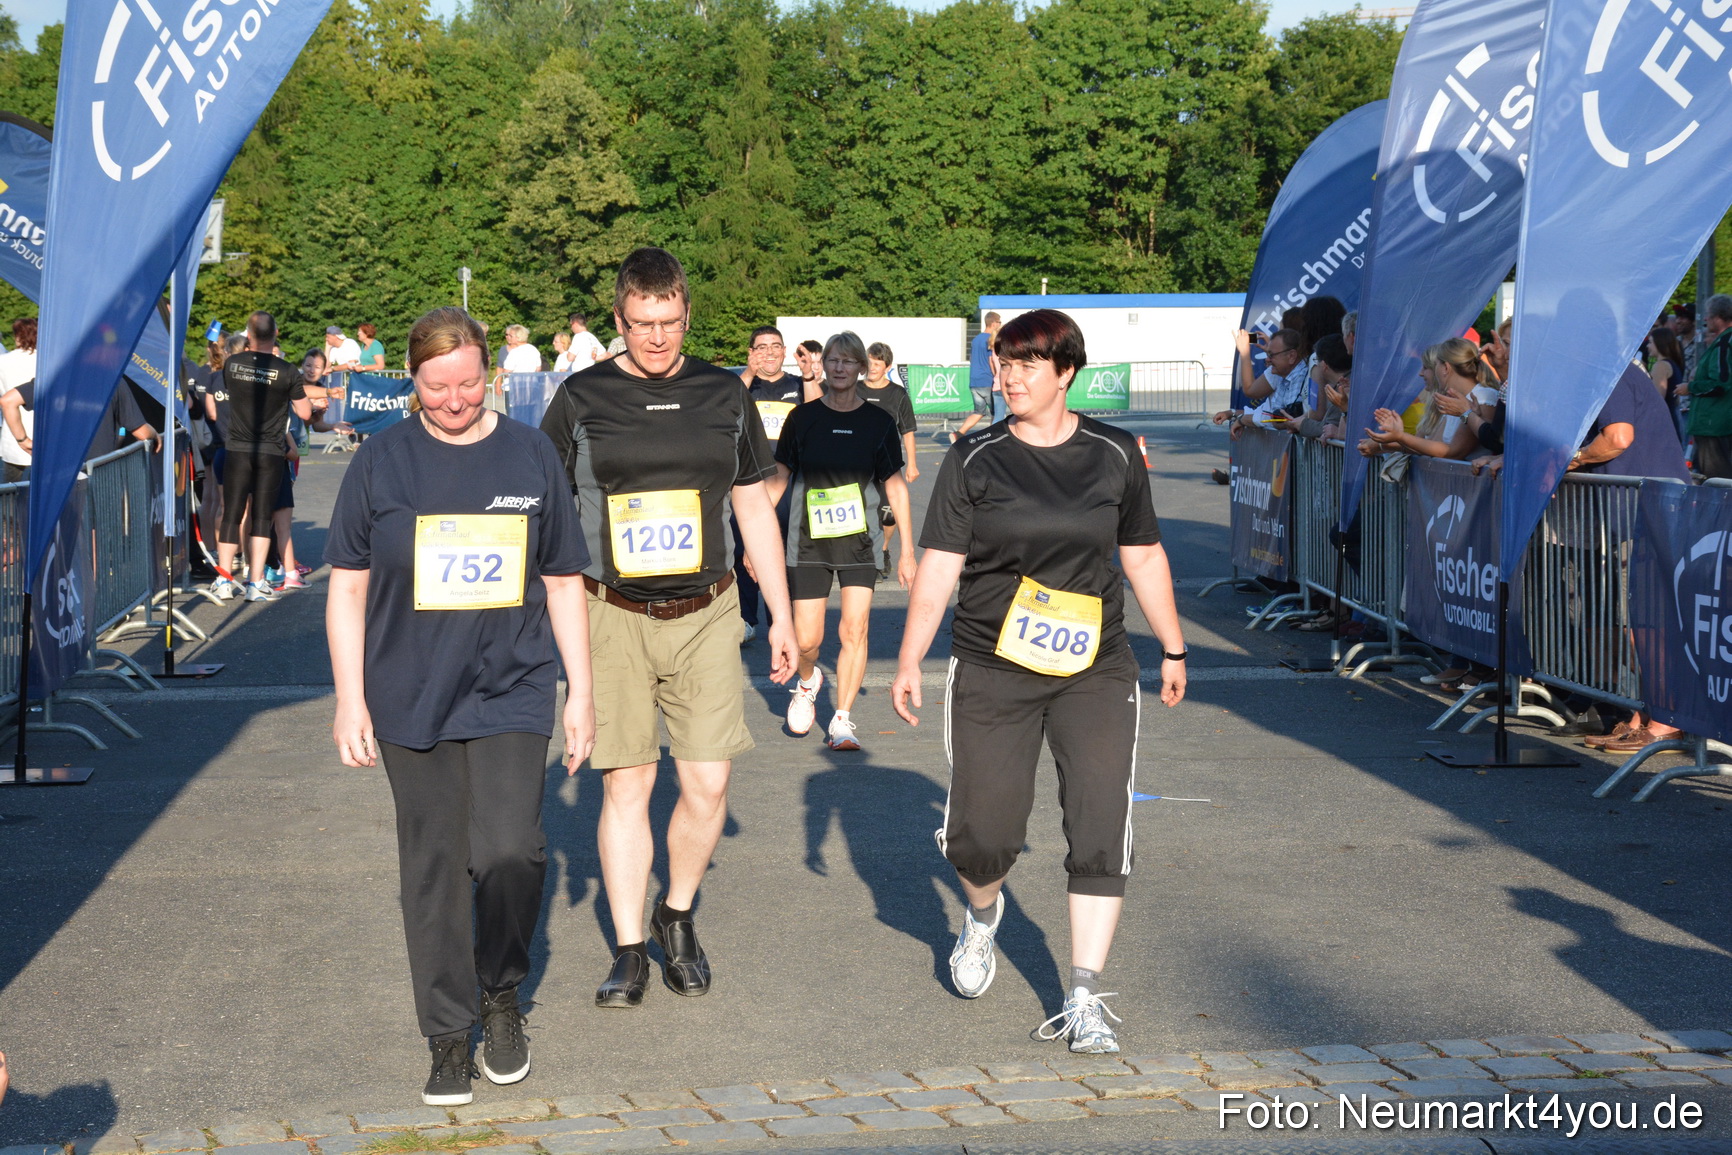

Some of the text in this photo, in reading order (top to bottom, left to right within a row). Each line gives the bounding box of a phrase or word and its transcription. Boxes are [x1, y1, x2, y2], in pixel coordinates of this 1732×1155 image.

[917, 373, 960, 397] AOK
[1088, 371, 1126, 393] AOK
[815, 505, 857, 524] 1191
[622, 523, 693, 553] 1202
[438, 553, 503, 583] 752
[1016, 616, 1090, 656] 1208
